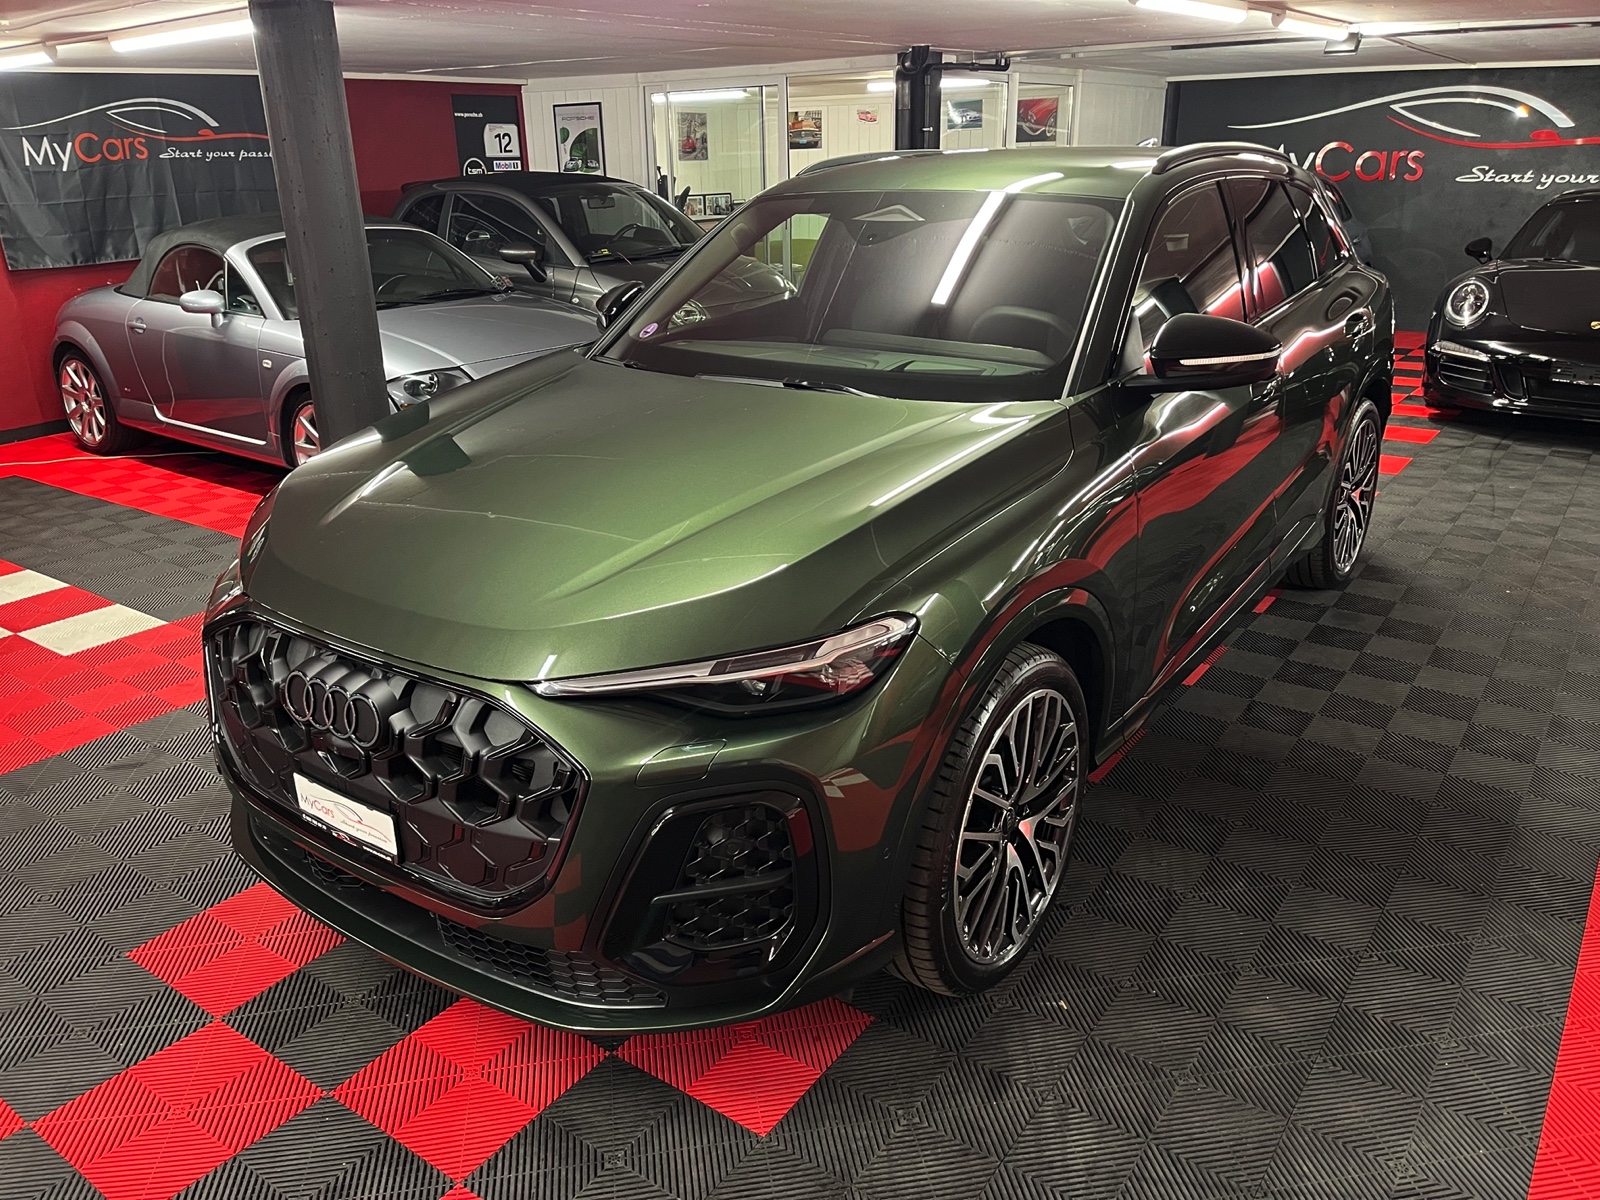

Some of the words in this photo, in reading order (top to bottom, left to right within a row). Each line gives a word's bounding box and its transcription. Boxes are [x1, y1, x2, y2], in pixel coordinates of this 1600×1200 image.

[22, 132, 149, 171] MyCars
[159, 147, 202, 158] Start
[205, 151, 235, 161] your
[494, 132, 513, 153] 12
[495, 162, 512, 170] Mobil
[1278, 141, 1425, 181] yCars
[1455, 165, 1534, 182] Start
[1535, 173, 1600, 190] your
[301, 793, 335, 819] MyCars
